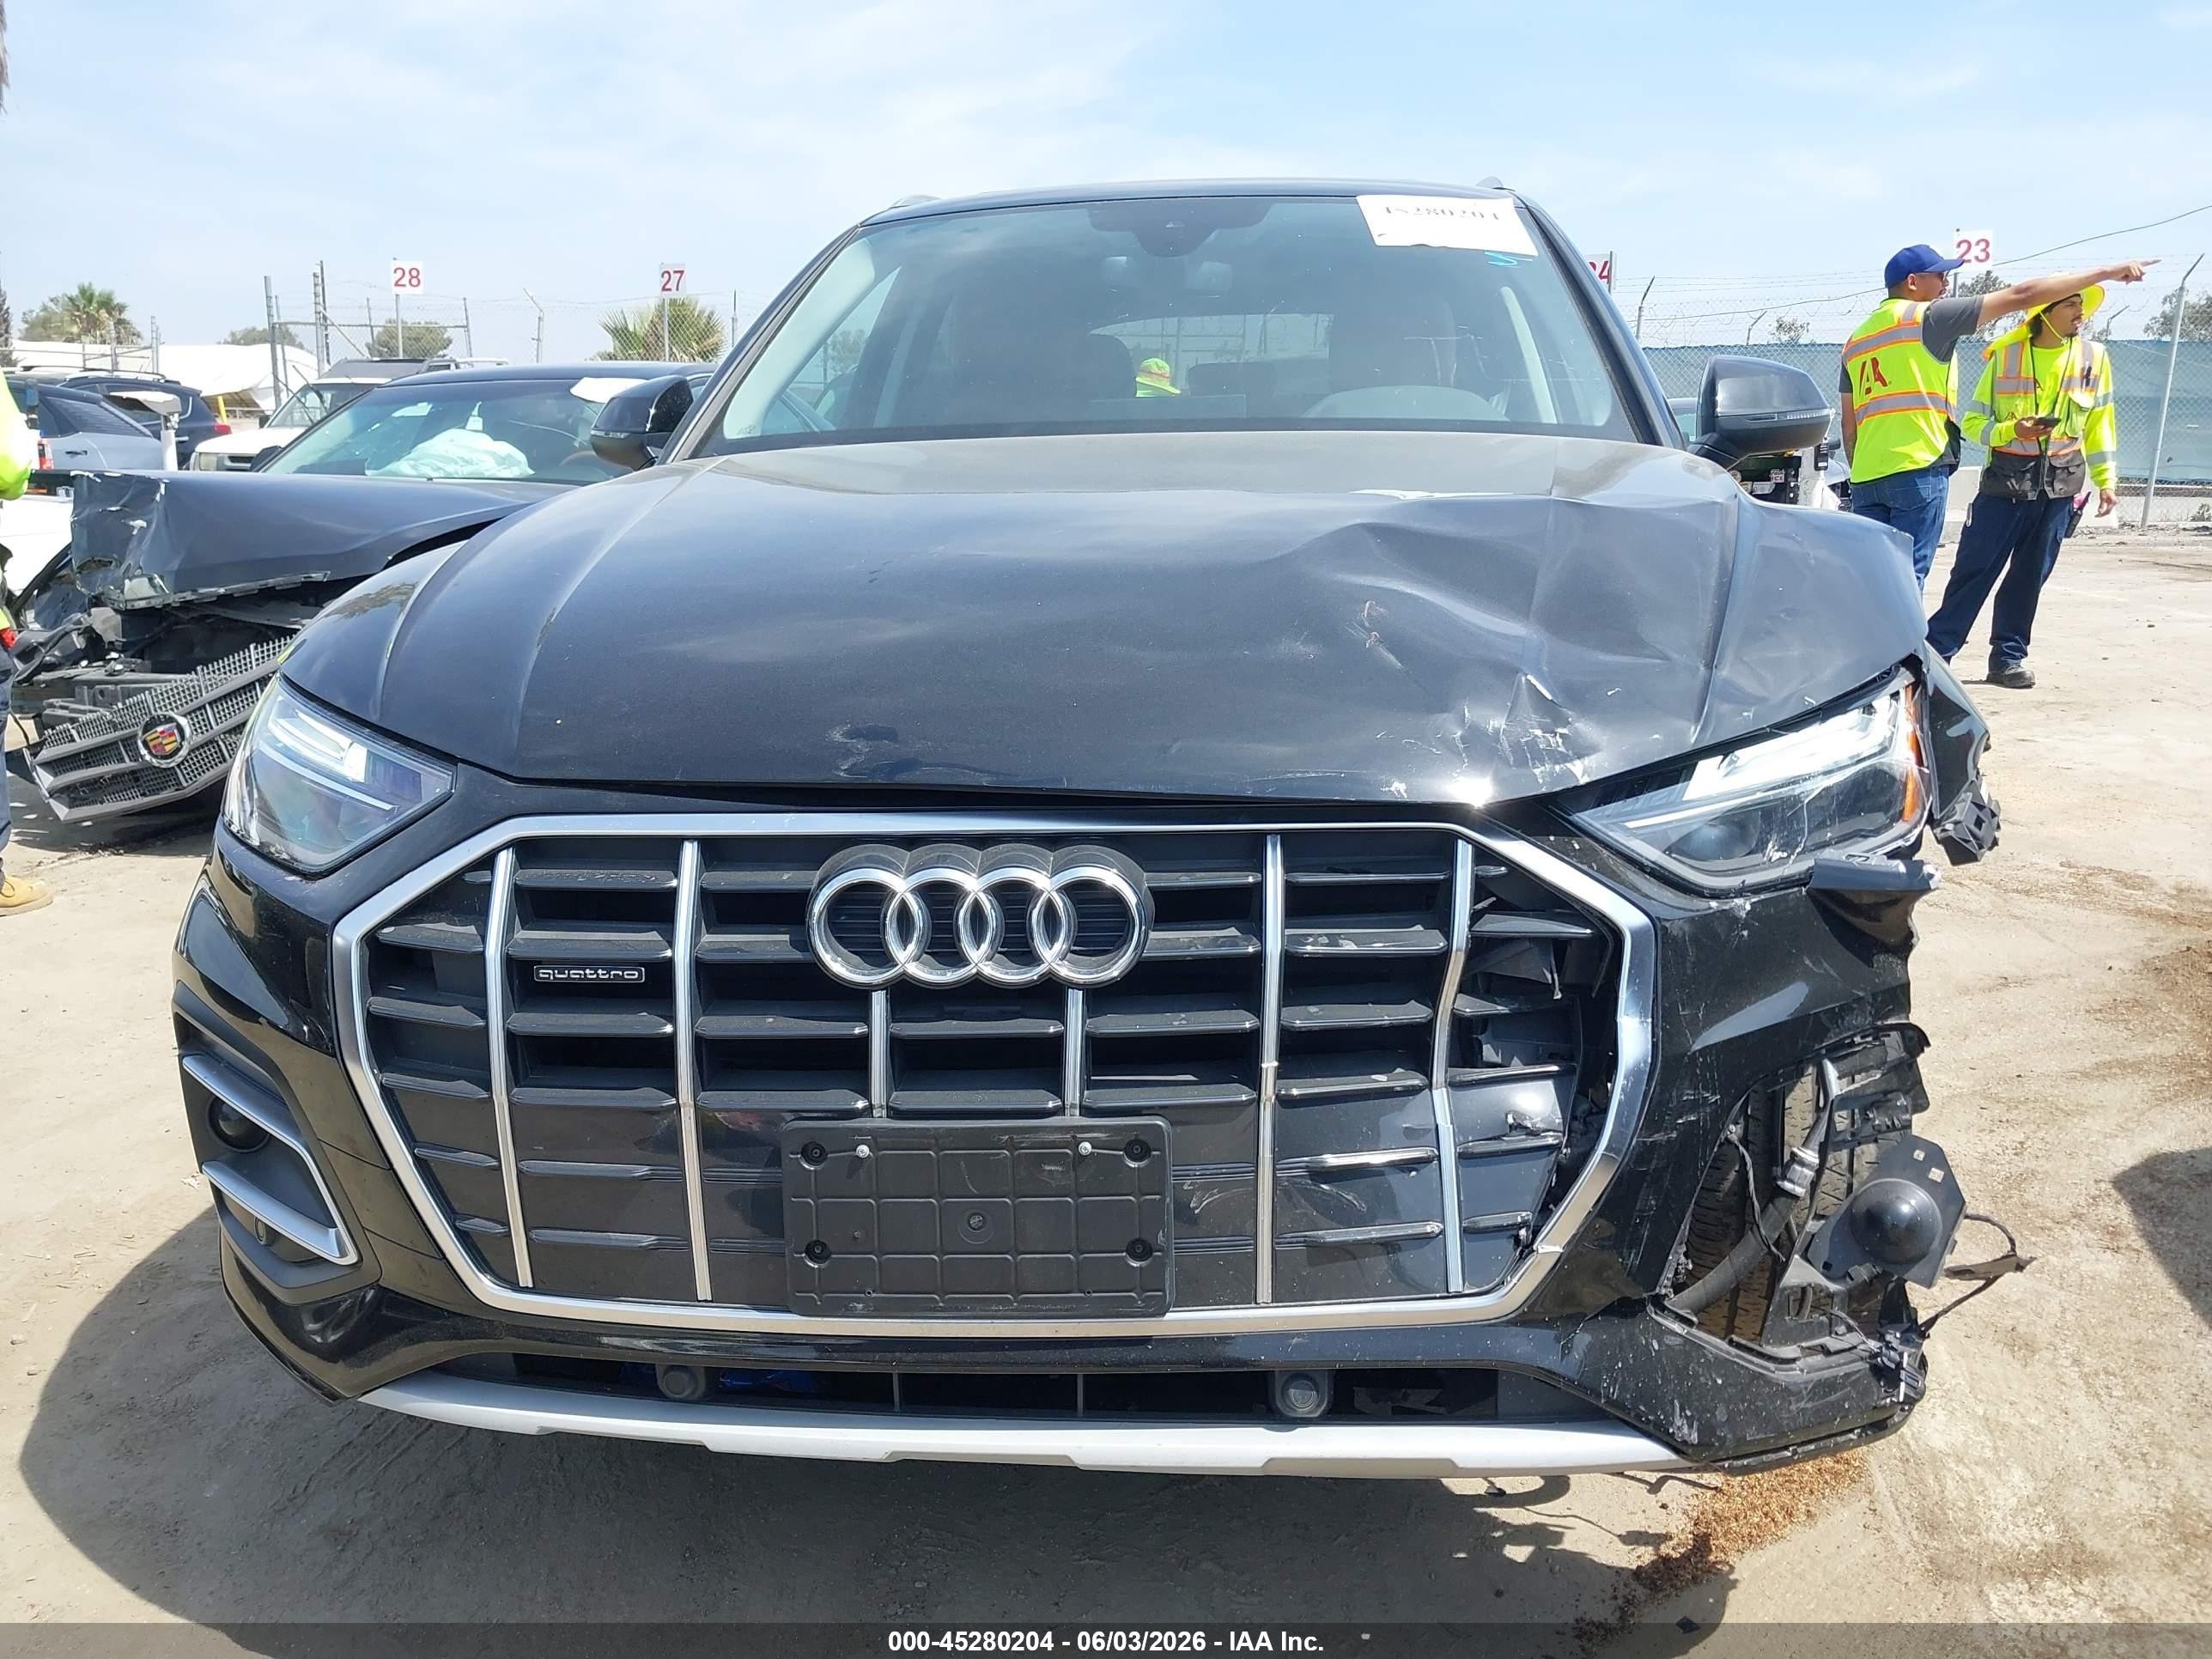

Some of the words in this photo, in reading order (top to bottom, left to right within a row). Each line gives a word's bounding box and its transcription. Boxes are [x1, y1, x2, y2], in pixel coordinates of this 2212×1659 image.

[1956, 238, 1990, 263] 23
[393, 267, 421, 288] 28
[661, 270, 685, 292] 27
[538, 968, 639, 981] quattro
